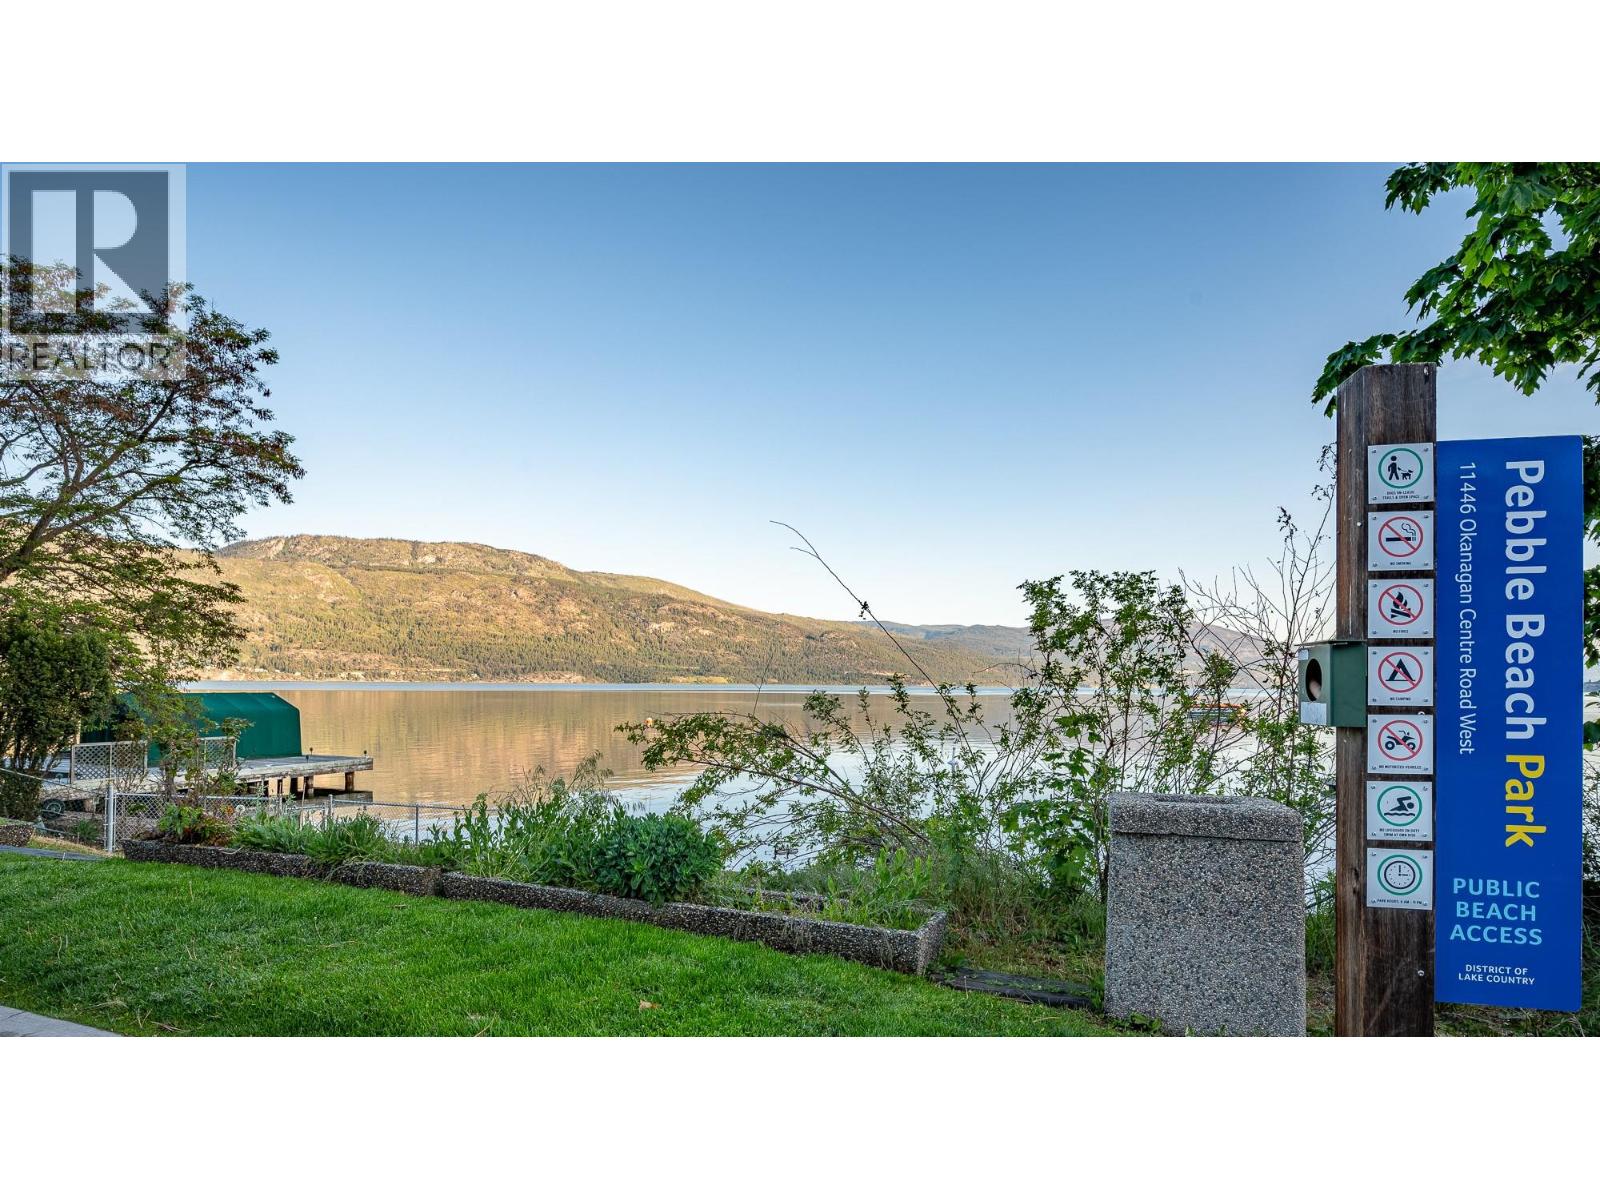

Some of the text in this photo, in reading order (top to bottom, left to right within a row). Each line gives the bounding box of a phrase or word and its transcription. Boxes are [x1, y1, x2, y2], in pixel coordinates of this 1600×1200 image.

[1454, 462, 1478, 755] 11446 Okanagan Centre Road West
[1504, 460, 1548, 848] Pebble Beach Park
[1453, 878, 1540, 899] PUBLIC
[1456, 901, 1536, 922] BEACH
[1449, 924, 1543, 946] ACCESS
[1458, 972, 1535, 986] LAKE COUNTRY
[1465, 964, 1529, 976] DISTRICT OF
